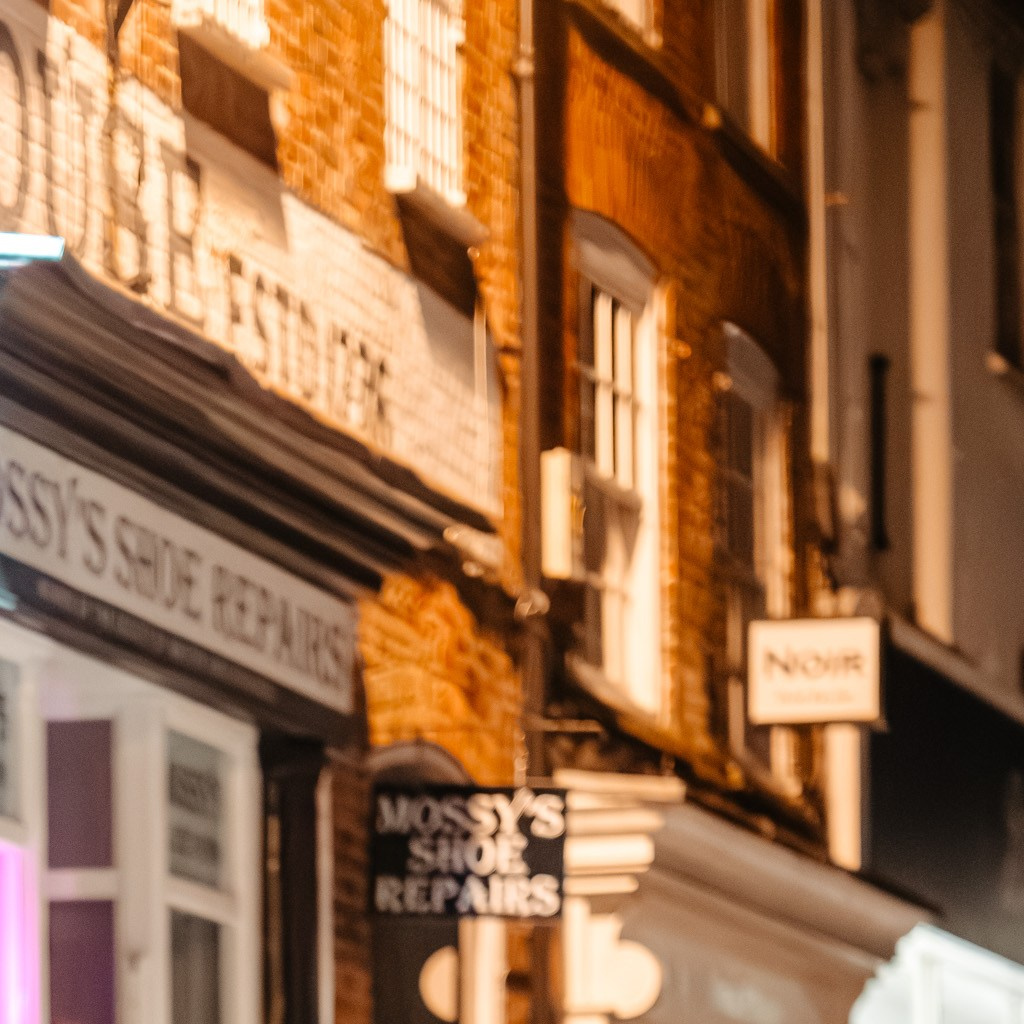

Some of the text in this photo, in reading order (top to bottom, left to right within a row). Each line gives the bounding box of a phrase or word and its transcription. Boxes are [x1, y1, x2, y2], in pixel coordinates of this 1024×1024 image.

[376, 788, 566, 840] MOSSY'S
[406, 832, 531, 877] SHOE
[375, 873, 561, 917] REPAIRS
